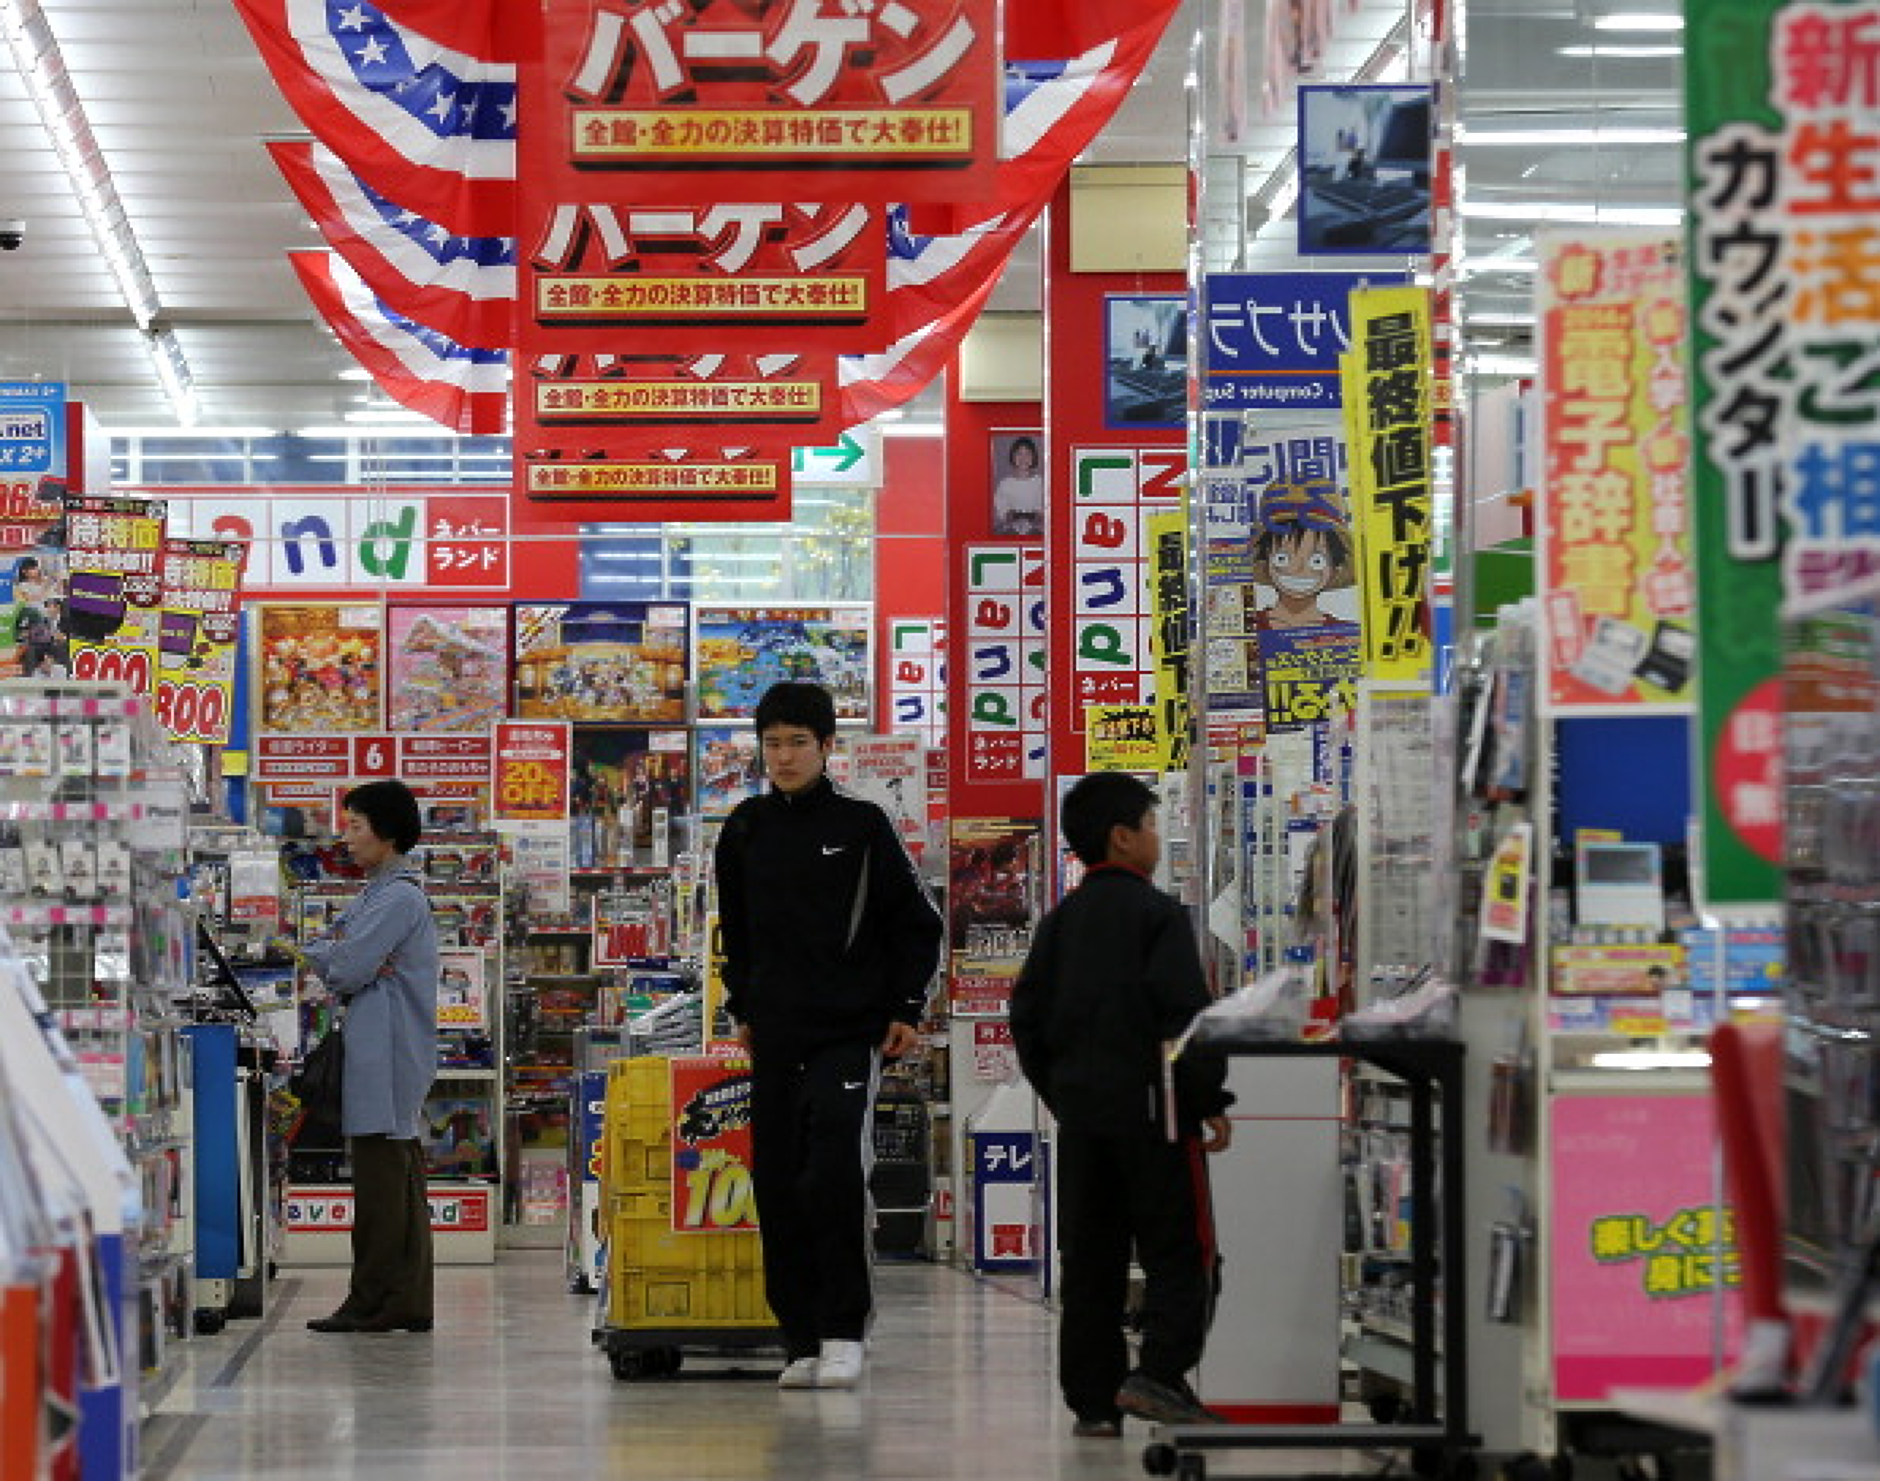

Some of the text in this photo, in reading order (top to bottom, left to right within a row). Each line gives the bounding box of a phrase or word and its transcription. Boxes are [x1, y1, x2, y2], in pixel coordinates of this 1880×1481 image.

[572, 0, 977, 105] バーゲン
[1707, 138, 1780, 543] カウンター
[433, 547, 500, 571] ランド
[1078, 457, 1132, 666] Land
[972, 553, 1017, 725] Land
[365, 742, 385, 770] 6
